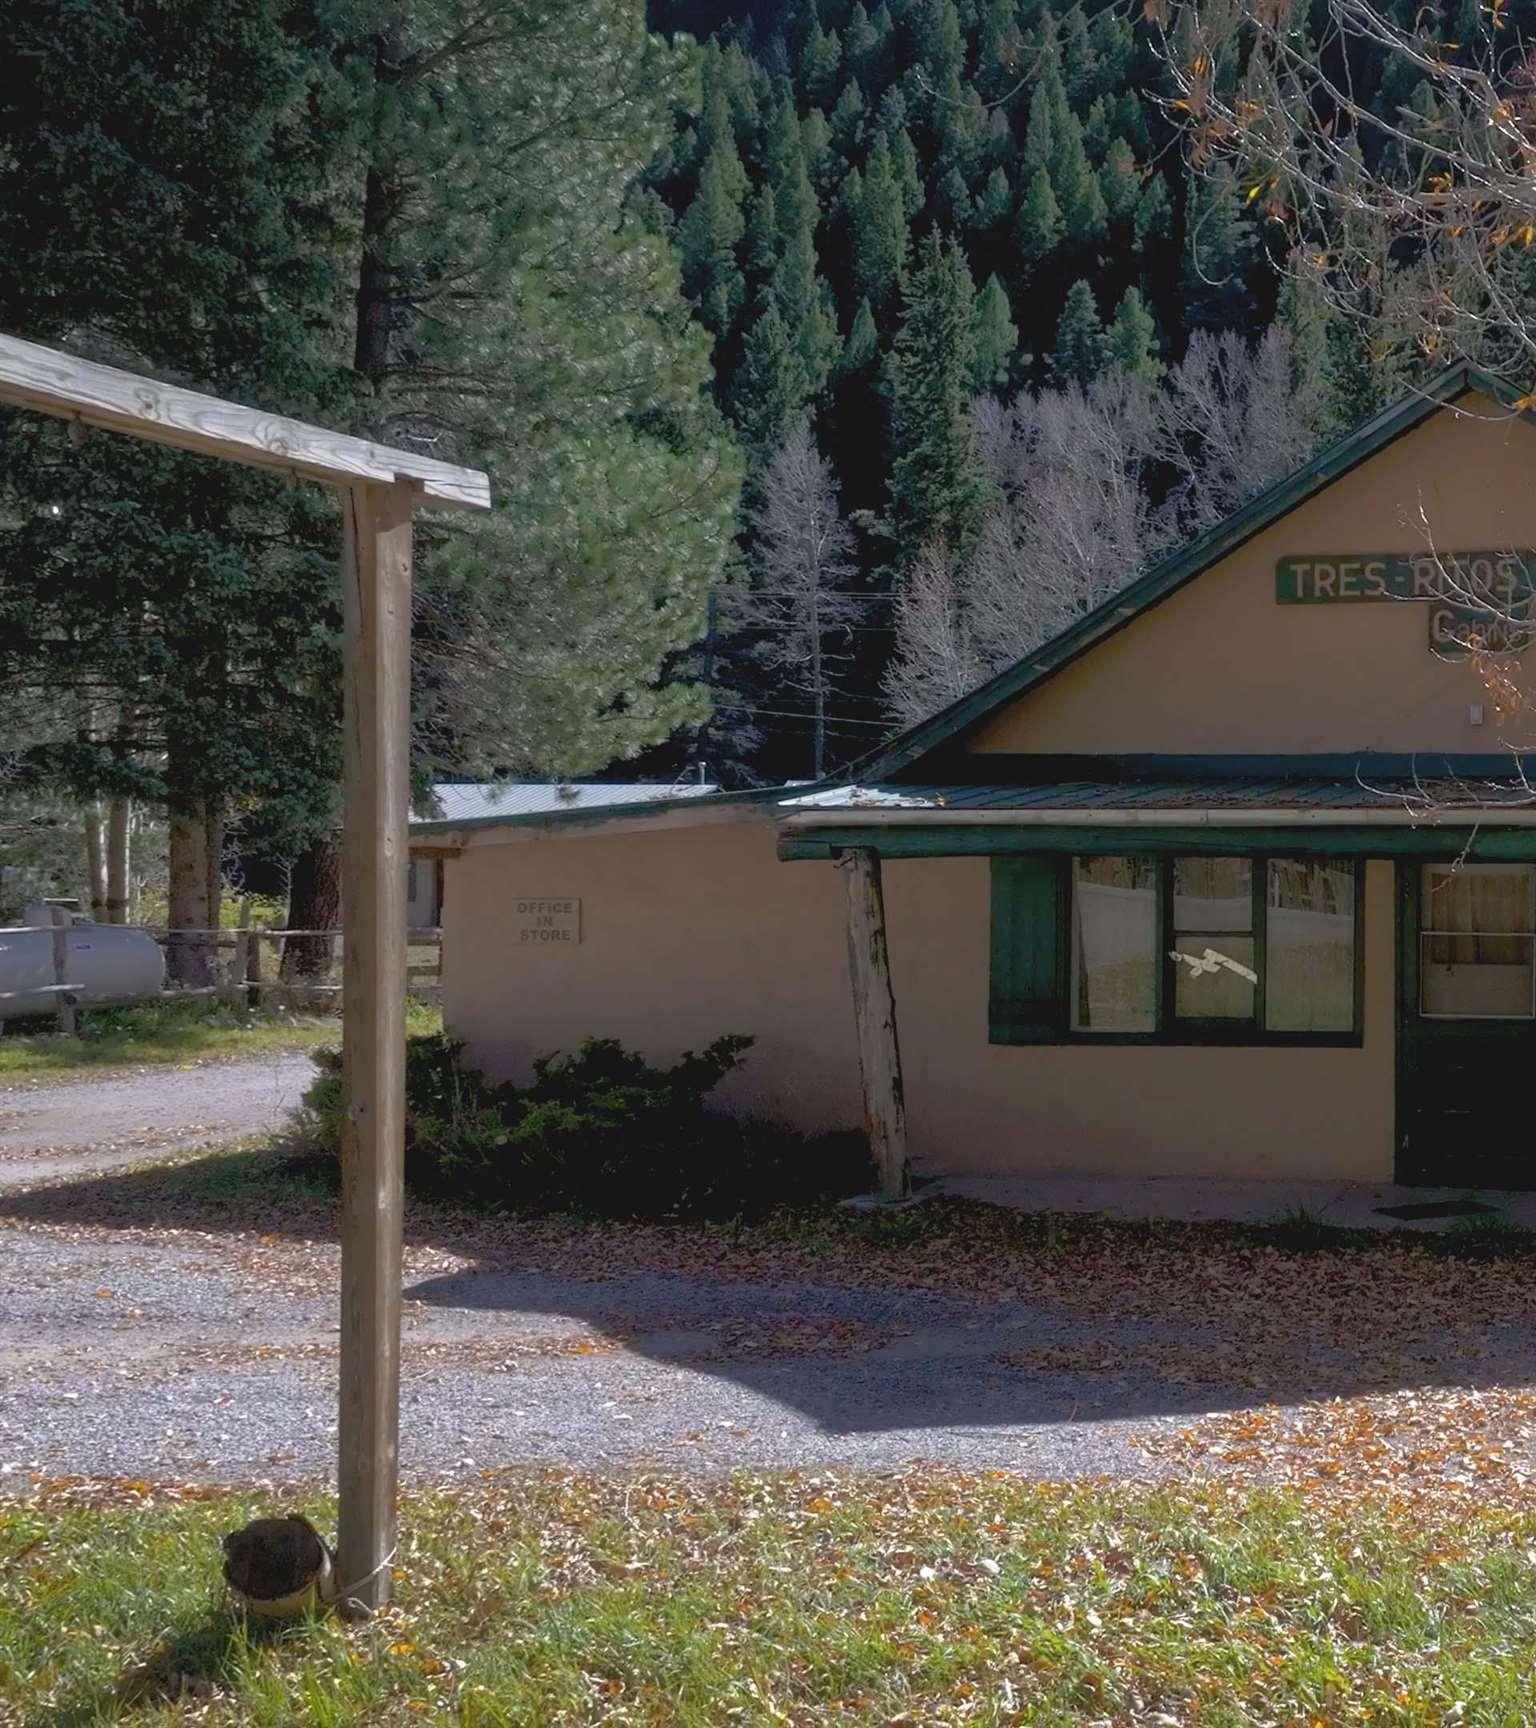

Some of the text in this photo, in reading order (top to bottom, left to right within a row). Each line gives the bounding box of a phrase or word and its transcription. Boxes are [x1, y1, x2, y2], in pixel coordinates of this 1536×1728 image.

[1289, 562, 1386, 597] TRES
[517, 902, 573, 913] OFFICE
[536, 915, 553, 927] IN
[520, 929, 571, 941] STORE
